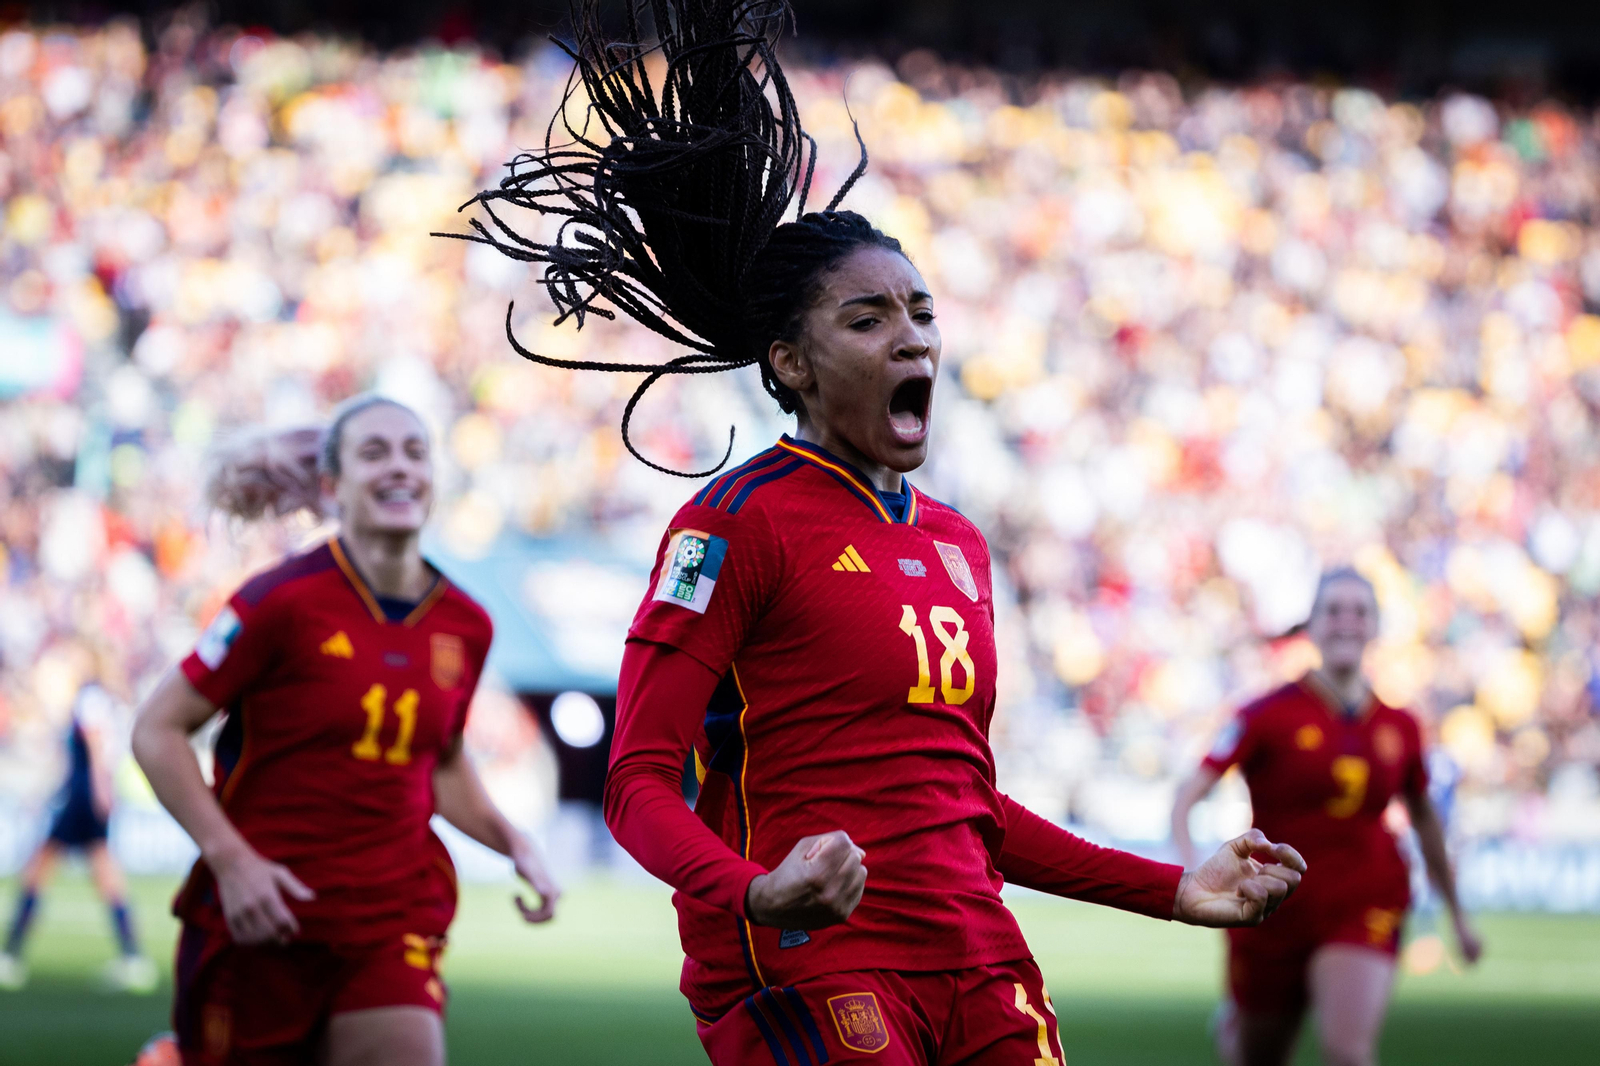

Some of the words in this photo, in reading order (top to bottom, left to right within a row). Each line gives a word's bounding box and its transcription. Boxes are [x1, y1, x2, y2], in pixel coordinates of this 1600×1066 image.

[898, 604, 975, 706] 18
[351, 683, 420, 766] 11
[1013, 983, 1067, 1066] 1
